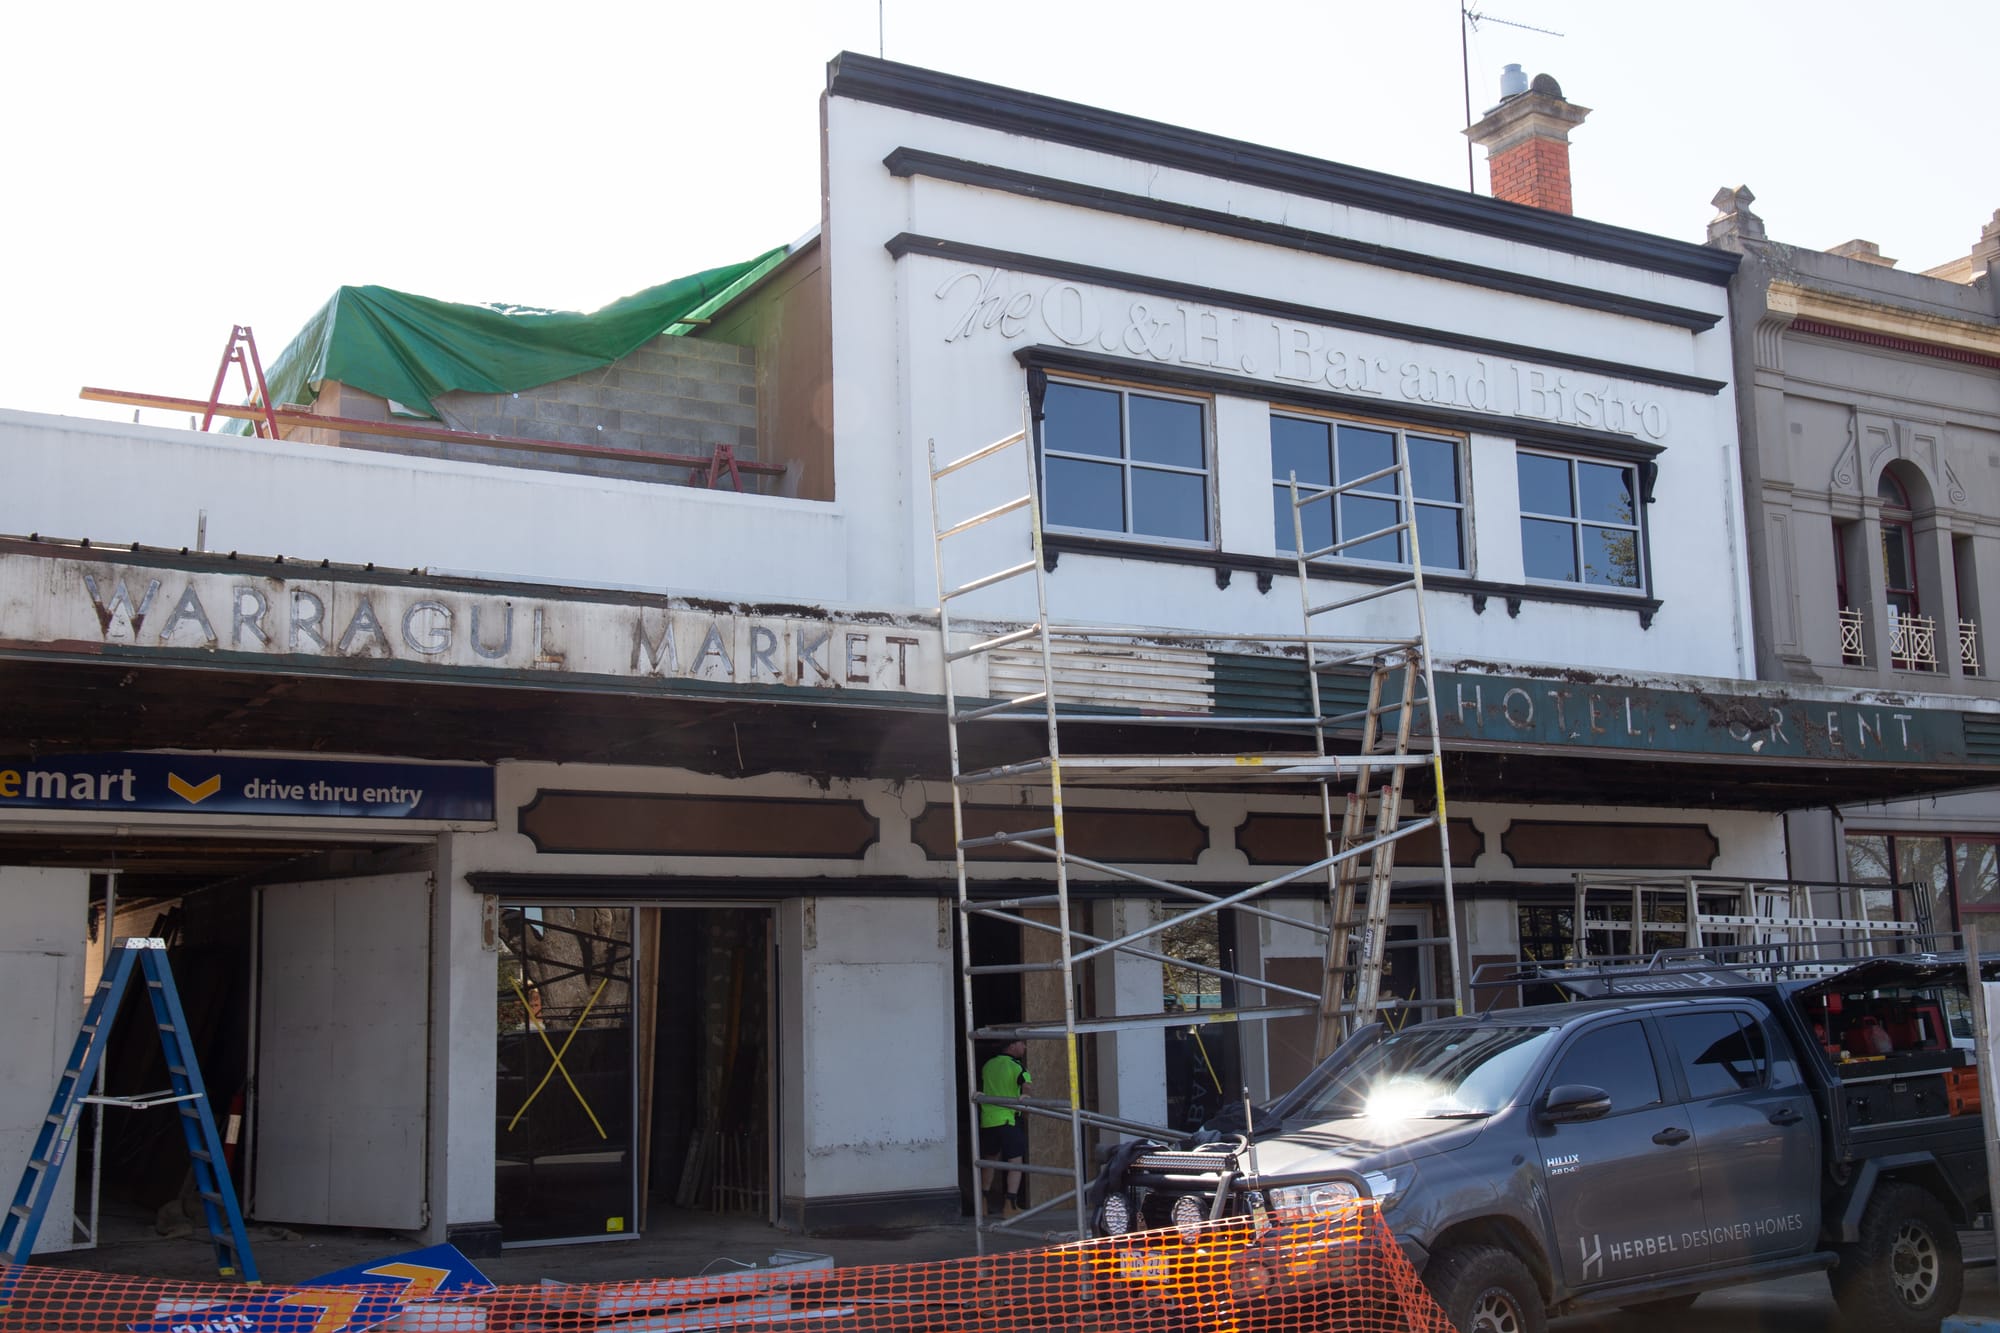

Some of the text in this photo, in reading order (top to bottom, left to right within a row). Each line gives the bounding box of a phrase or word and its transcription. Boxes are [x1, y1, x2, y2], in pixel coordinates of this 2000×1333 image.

[935, 266, 1032, 343] The
[1271, 321, 1390, 395] Bar
[1400, 357, 1499, 413] and
[1512, 362, 1669, 440] Bistro
[83, 573, 920, 686] WARRAGUL MARKET
[1456, 683, 1642, 736] HOTEL
[243, 778, 423, 808] drive thru entry
[1546, 1154, 1580, 1167] HILUX
[1610, 1235, 1678, 1262] HERBEL
[1682, 1223, 1751, 1249] DESIGNER
[1755, 1214, 1803, 1237] HOMES
